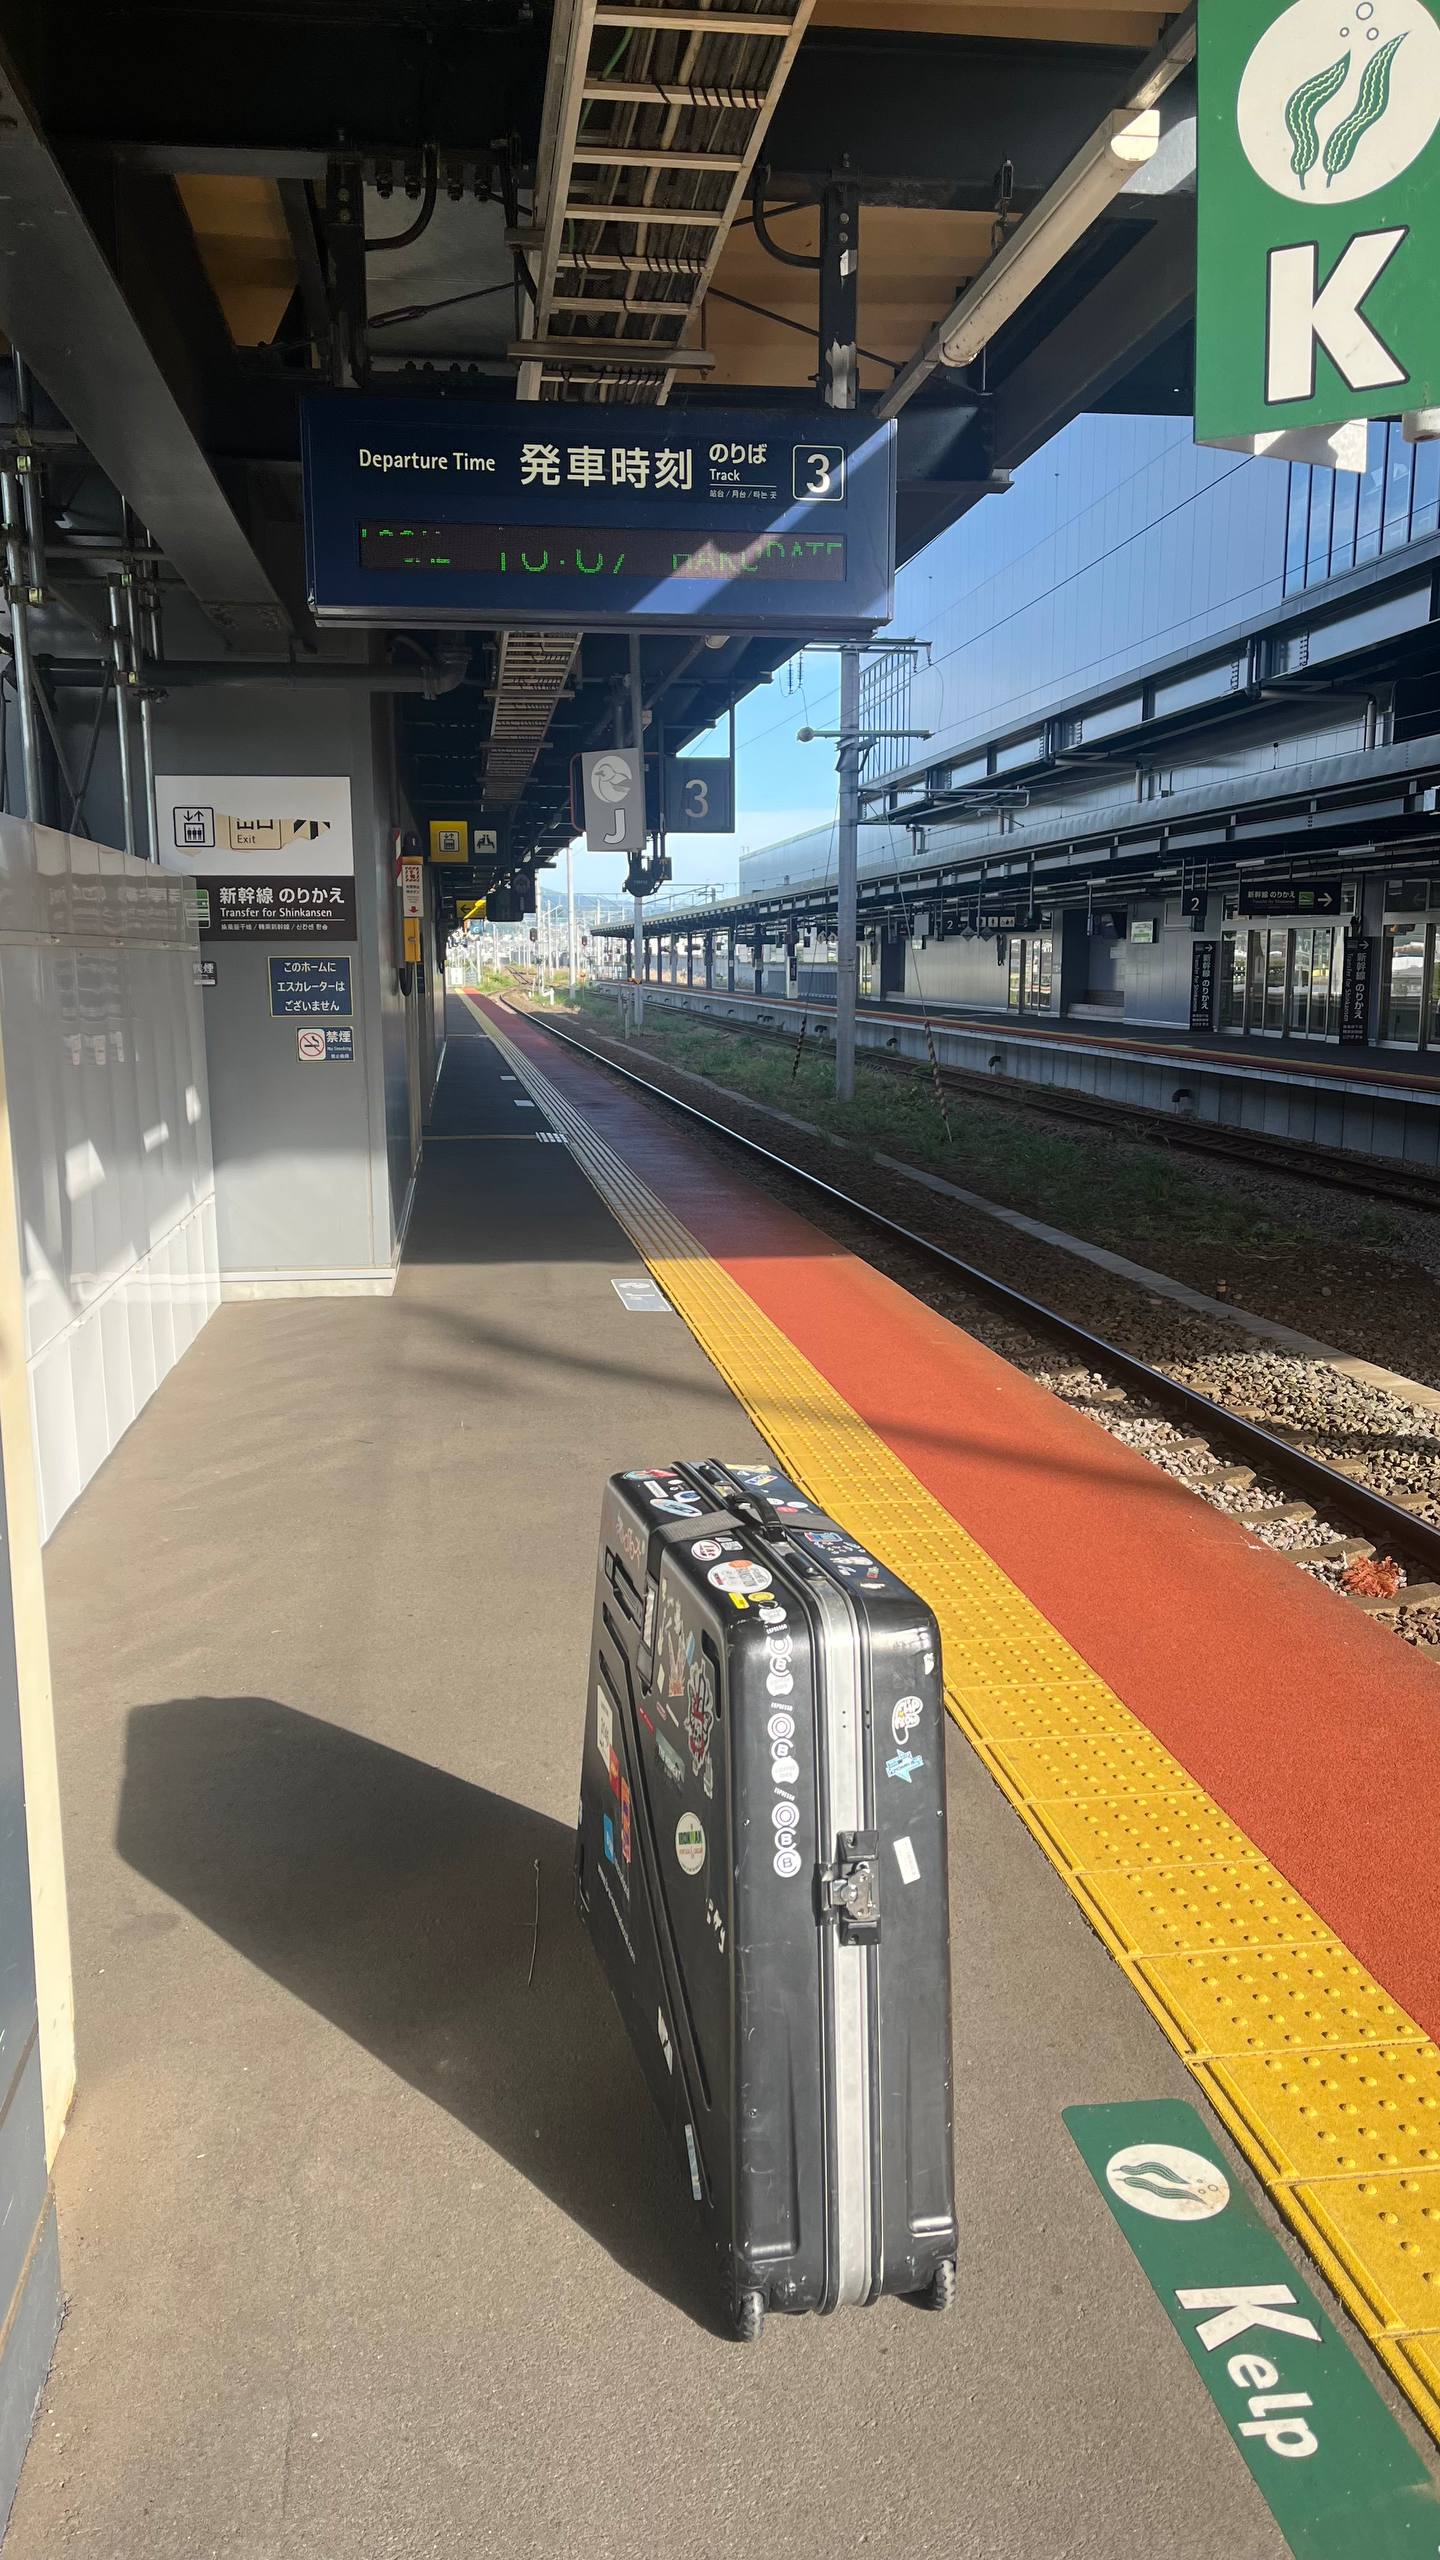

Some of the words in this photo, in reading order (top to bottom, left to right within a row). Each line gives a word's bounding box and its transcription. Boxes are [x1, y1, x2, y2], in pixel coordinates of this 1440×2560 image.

[1264, 224, 1410, 405] K
[359, 449, 448, 472] Departure
[453, 452, 496, 471] Time
[709, 443, 768, 464] のりば
[520, 443, 693, 490] 発車時刻
[806, 453, 831, 493] 3
[709, 468, 741, 481] Track
[685, 779, 709, 818] 3
[603, 808, 626, 844] J
[237, 834, 256, 844] Exit
[1191, 897, 1199, 911] 2
[220, 907, 260, 918] Transfer
[262, 907, 276, 917] for
[279, 907, 332, 918] Shinkansen
[947, 920, 954, 930] 2
[284, 962, 336, 973] このホームに
[277, 981, 345, 992] エスカレーターは
[284, 1000, 340, 1012] ございません
[326, 1030, 352, 1043] 禁煙
[1174, 2284, 1323, 2458] Kelp
